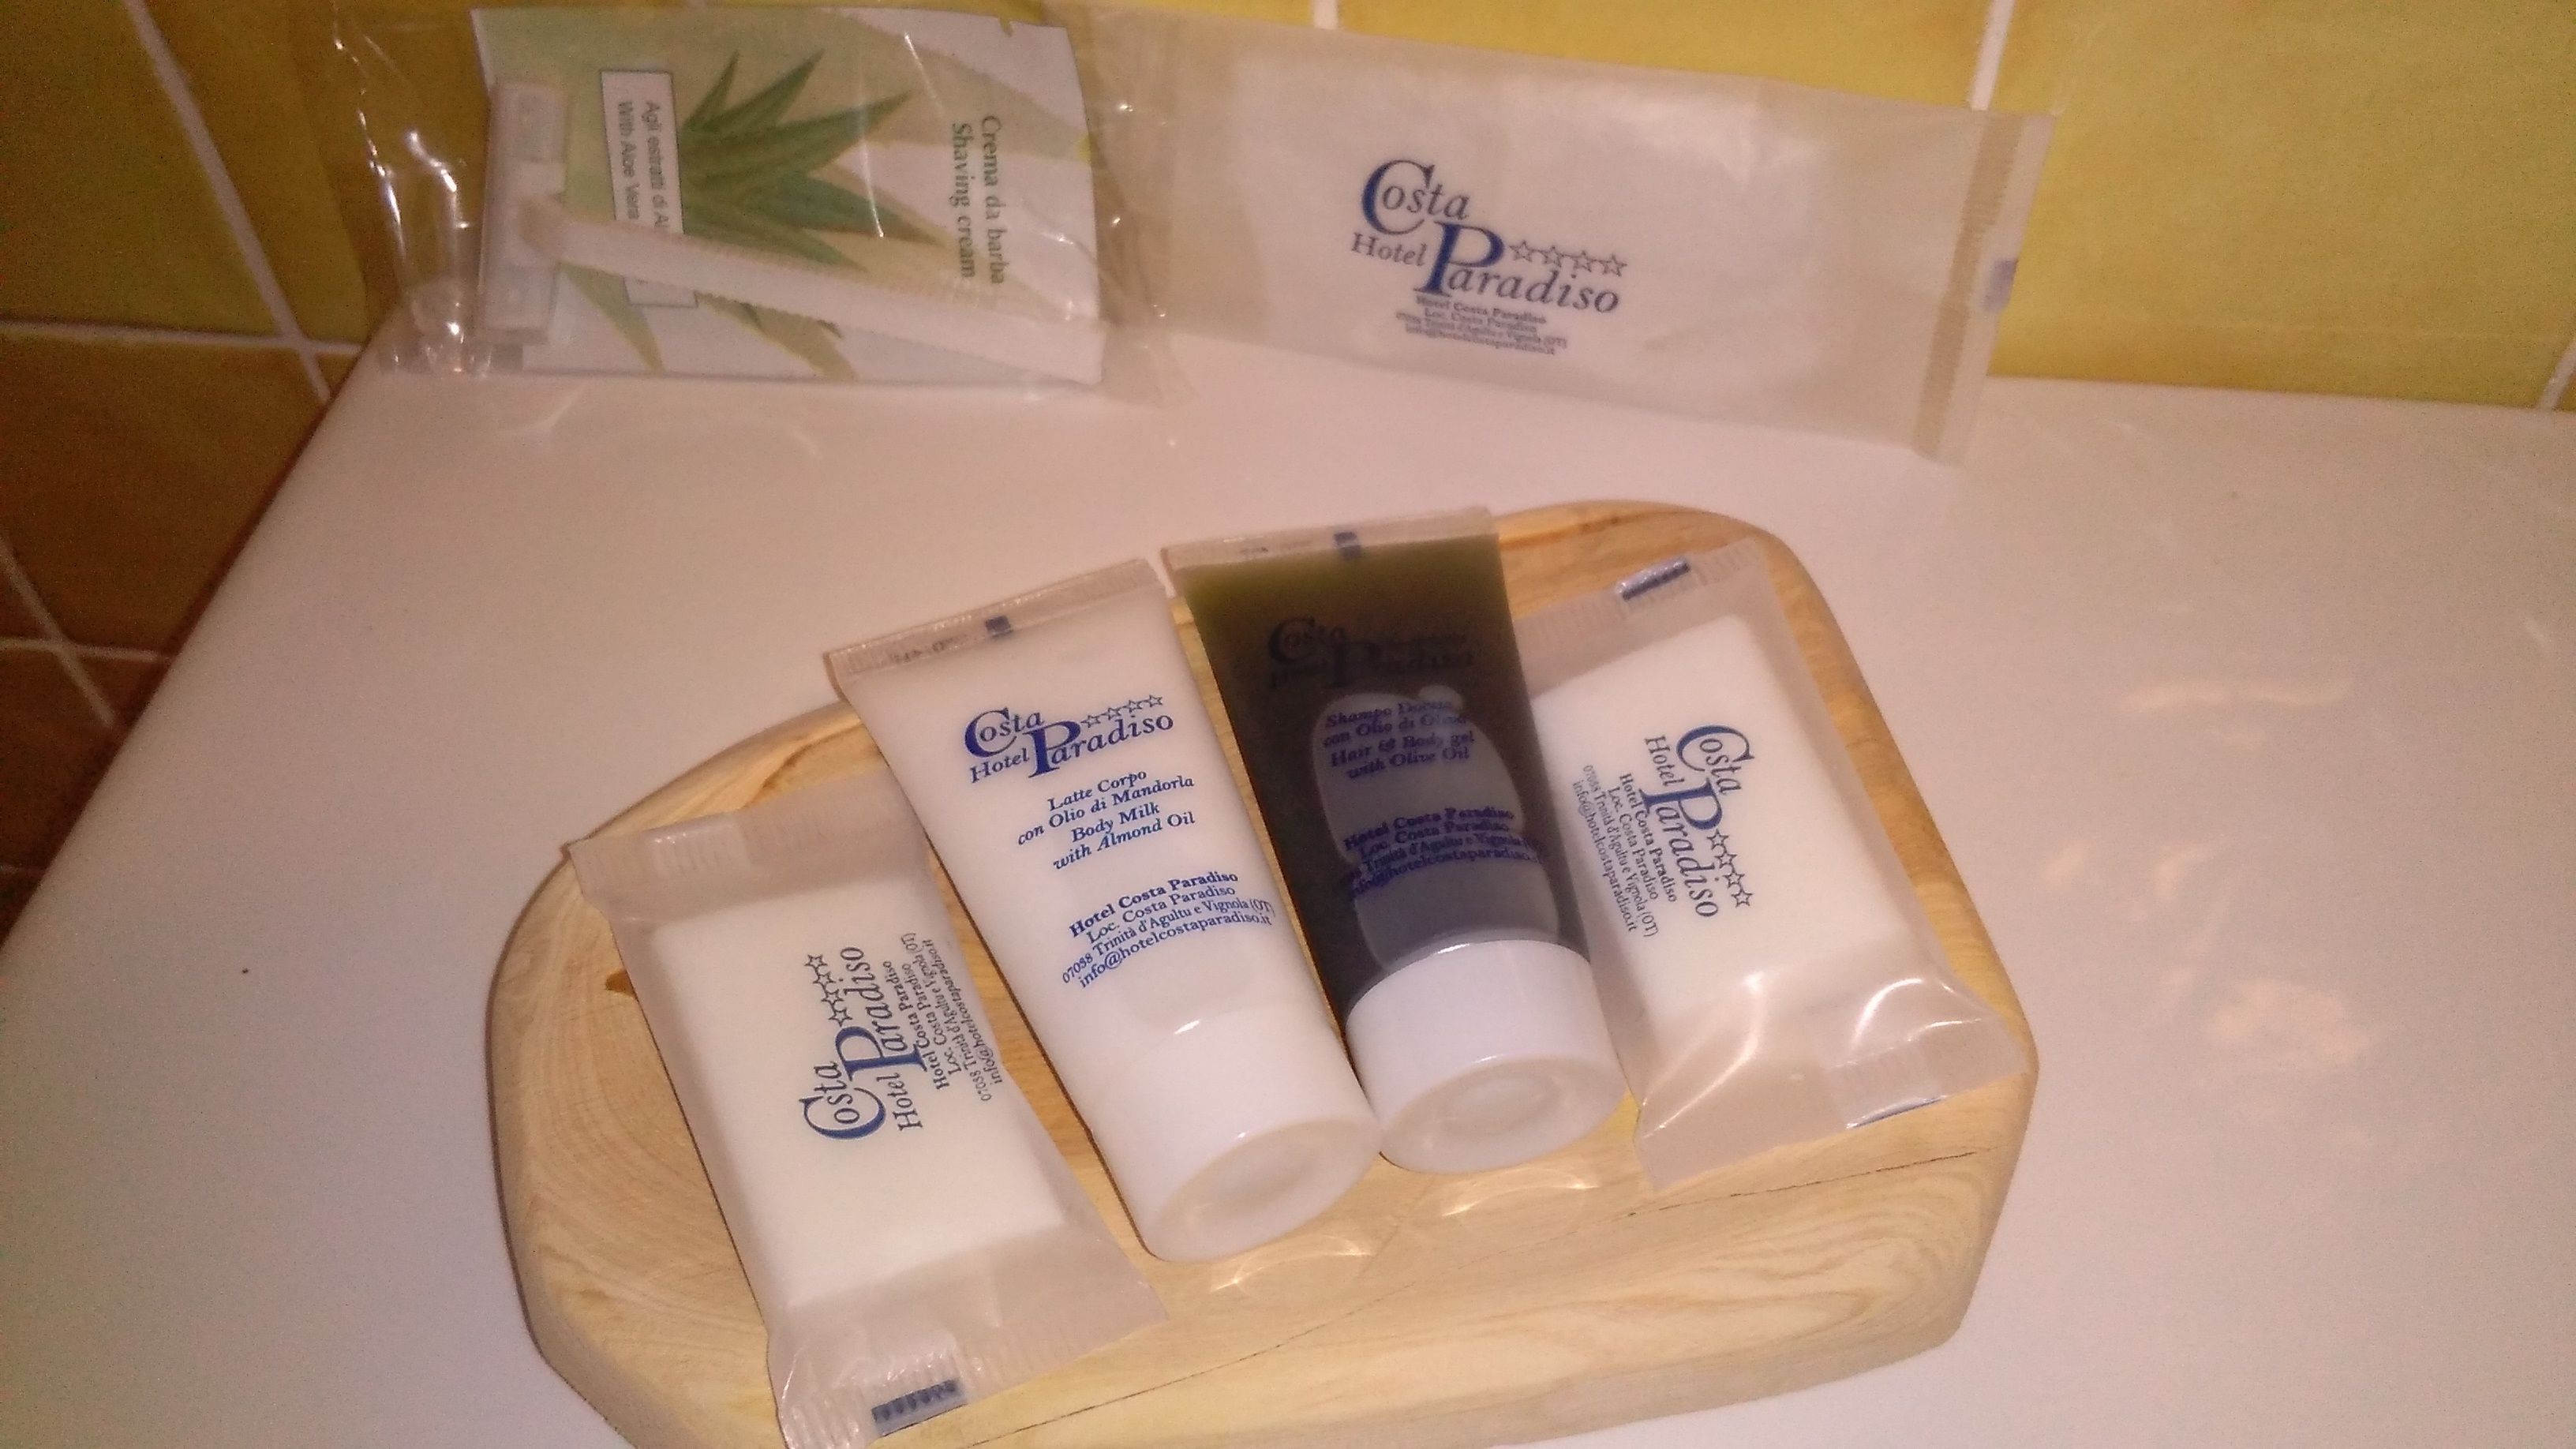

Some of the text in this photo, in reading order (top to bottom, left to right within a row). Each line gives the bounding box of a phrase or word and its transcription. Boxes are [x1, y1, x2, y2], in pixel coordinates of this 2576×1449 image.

[618, 100, 641, 220] With Aloe Vera
[653, 211, 670, 228] Al
[949, 122, 975, 278] Shaving cream
[982, 115, 1010, 283] Crema da barba
[1361, 159, 1470, 236] Costa
[1351, 233, 1428, 267] Hotel
[1413, 220, 1619, 313] Paradiso
[1268, 617, 1348, 663] Costa
[964, 706, 1045, 758] Costa
[970, 747, 1029, 783] Hotel
[1023, 713, 1174, 779] Paradiso
[1323, 732, 1350, 748] con
[1355, 719, 1392, 737] Olio
[1398, 716, 1414, 729] di
[1330, 730, 1476, 768] Hair & Body gel
[1346, 746, 1470, 780] with Olive Oil
[1645, 735, 1685, 787] Hotel
[1676, 725, 1755, 796] Costa
[1017, 775, 1195, 845] con Olio di Mandorla
[1047, 770, 1147, 811] Latte Corpo
[1071, 801, 1160, 843] Body Milk
[1053, 811, 1196, 870] with Almond Oil
[1343, 806, 1515, 852] Hotel Costa Paradiso
[1395, 826, 1440, 844] Costa
[1572, 780, 1638, 933] info@hotelcostaparadiso.it
[1608, 787, 1659, 901] Loc. Costa Paradiso
[1619, 773, 1677, 903] Hotel Costa Paradiso
[1639, 777, 1722, 916] Paradiso
[1069, 871, 1238, 938] Hotel Costa Paradiso
[1086, 884, 1235, 943] Loc. Costa Paradiso
[1092, 927, 1137, 957] Trinità
[1138, 908, 1193, 933] d'Agultu
[1201, 899, 1249, 915] Vignola
[1626, 872, 1647, 912] Vignola
[1642, 912, 1659, 938] (OT)
[1079, 909, 1272, 988] info@hotelcostaparadiso.it
[835, 947, 928, 1082] Paradiso
[882, 960, 950, 1090] Hotel Costa Paradiso
[901, 963, 962, 1076] Loc. Costa Paradiso
[922, 939, 1003, 1085] info@hotelcostaparadiso.it
[799, 1061, 886, 1140] Costa
[876, 1073, 923, 1131] Hotel
